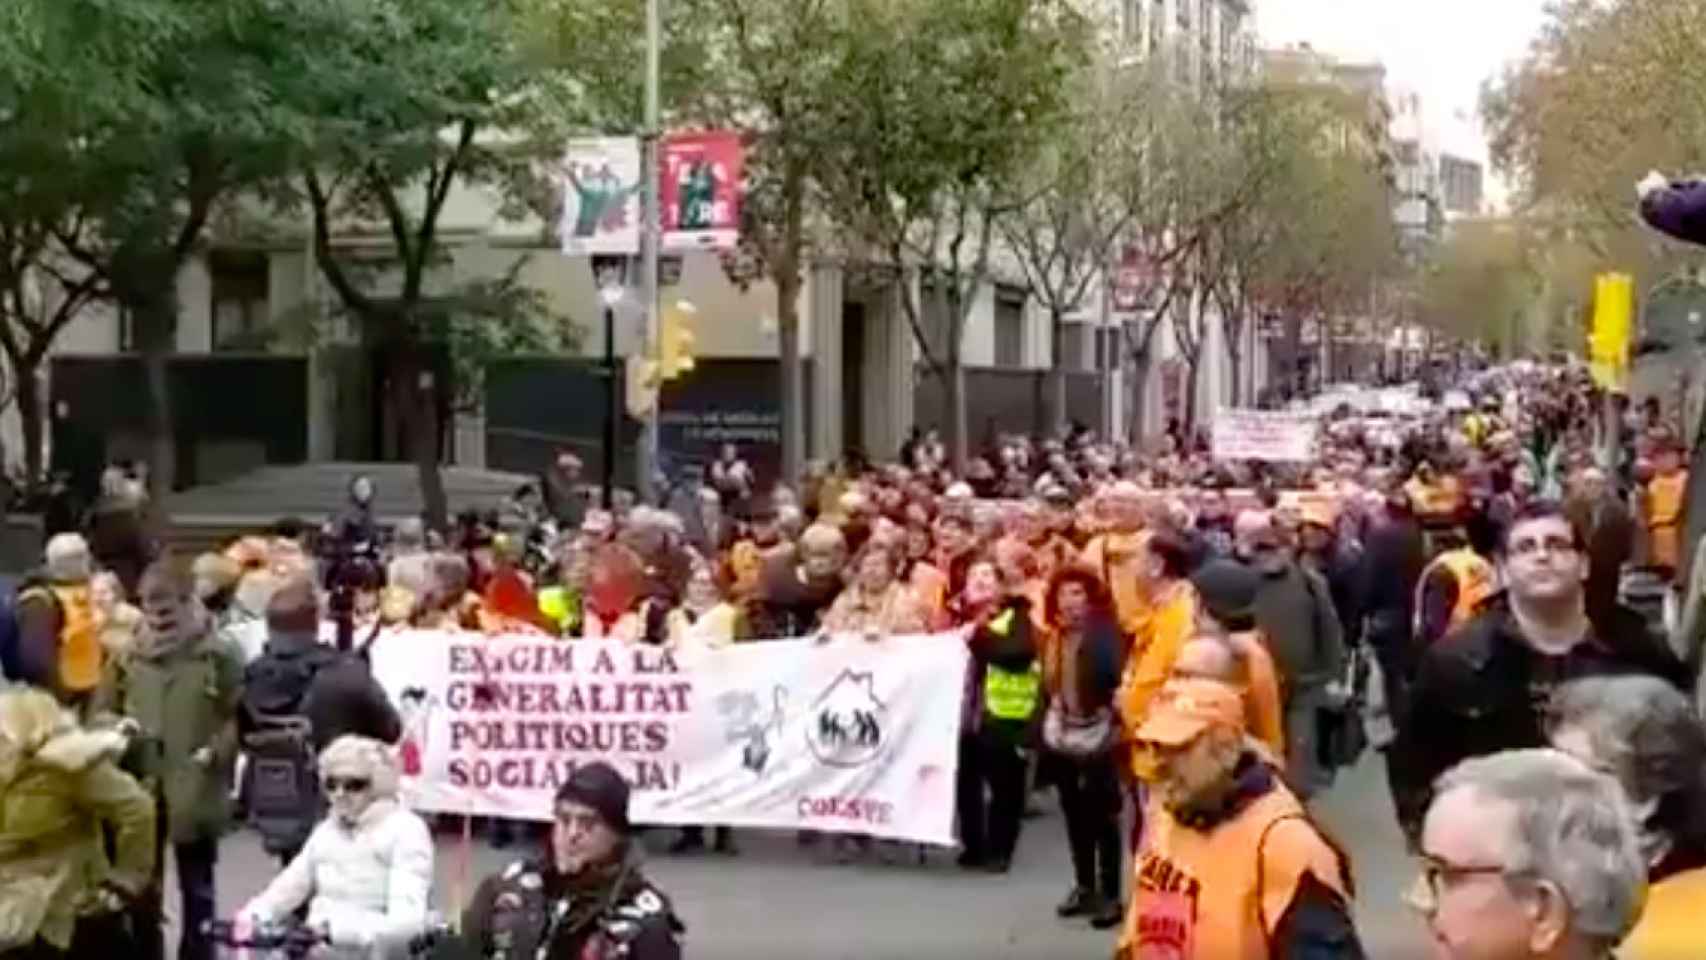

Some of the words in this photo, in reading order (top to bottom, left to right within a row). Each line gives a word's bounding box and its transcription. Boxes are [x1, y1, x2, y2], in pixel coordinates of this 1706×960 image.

[592, 648, 615, 673] A
[633, 648, 678, 673] LA
[450, 721, 667, 751] POLITIQUES
